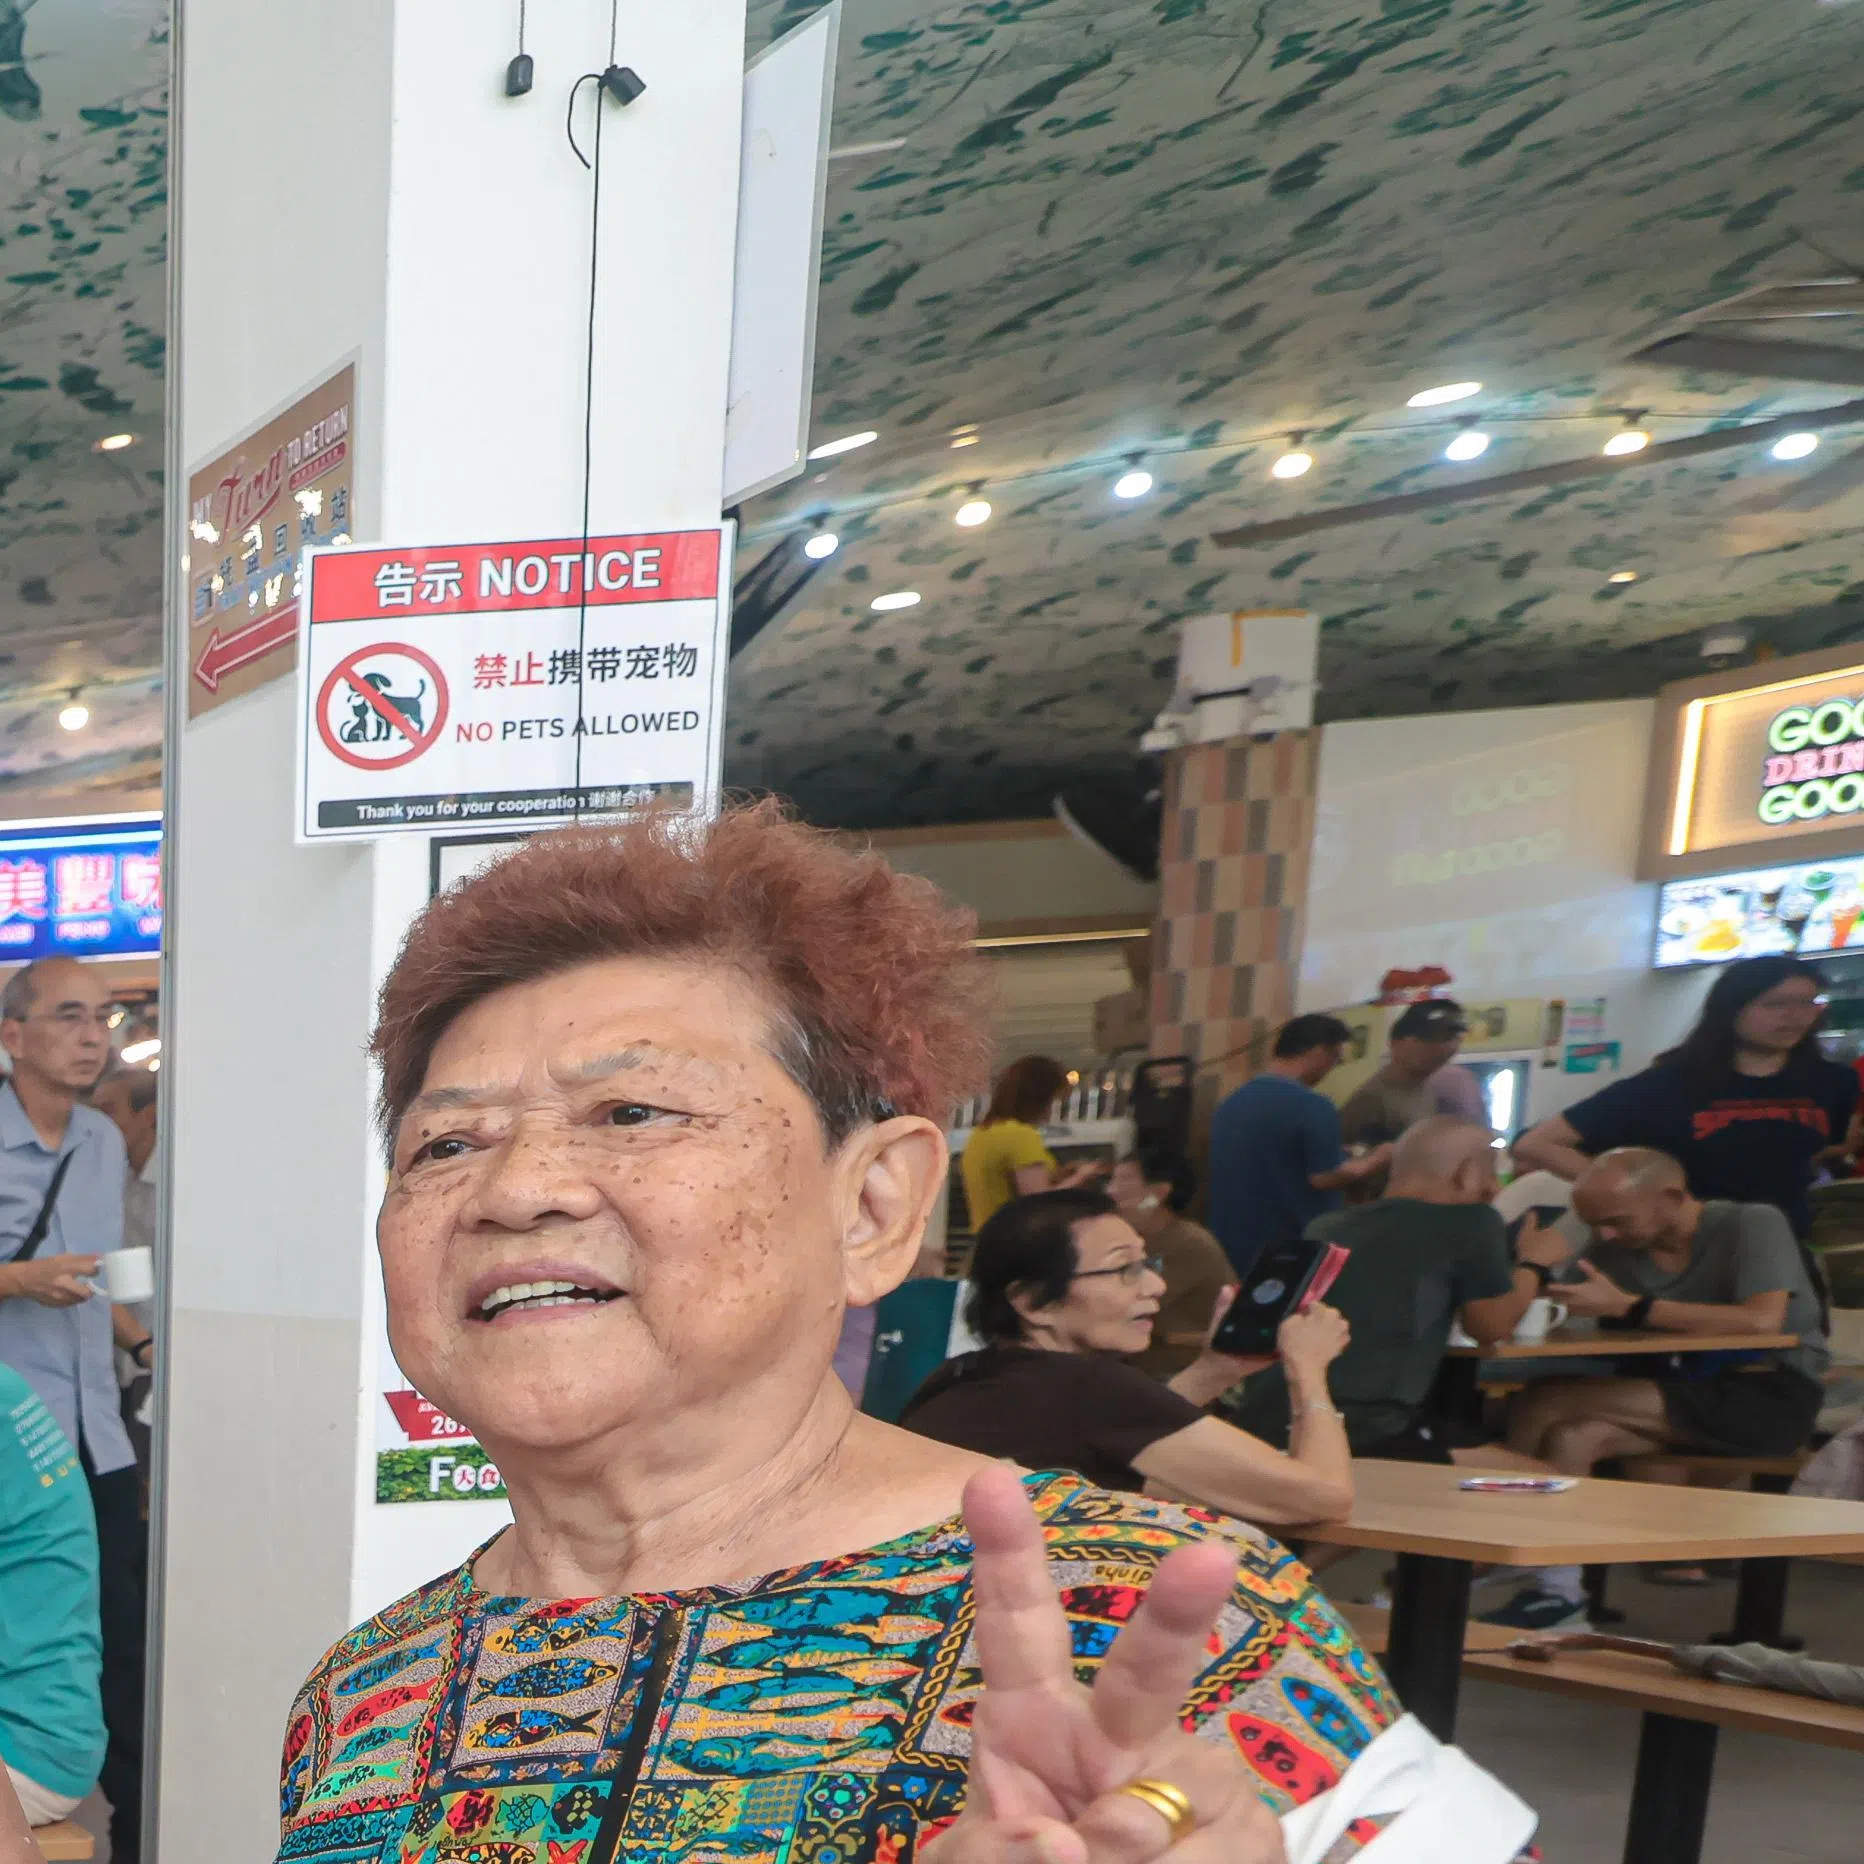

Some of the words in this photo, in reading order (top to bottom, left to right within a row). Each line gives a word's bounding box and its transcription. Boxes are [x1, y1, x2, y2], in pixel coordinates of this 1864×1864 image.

[373, 558, 464, 609] 告示
[478, 548, 663, 598] NOTICE
[472, 641, 699, 690] 禁止携带宠物
[456, 721, 493, 743] NO
[502, 717, 564, 741] PETS
[571, 710, 700, 738] ALLOWED
[356, 804, 404, 820] Thank
[407, 801, 434, 822] you
[436, 799, 459, 817] for
[460, 798, 495, 818] your
